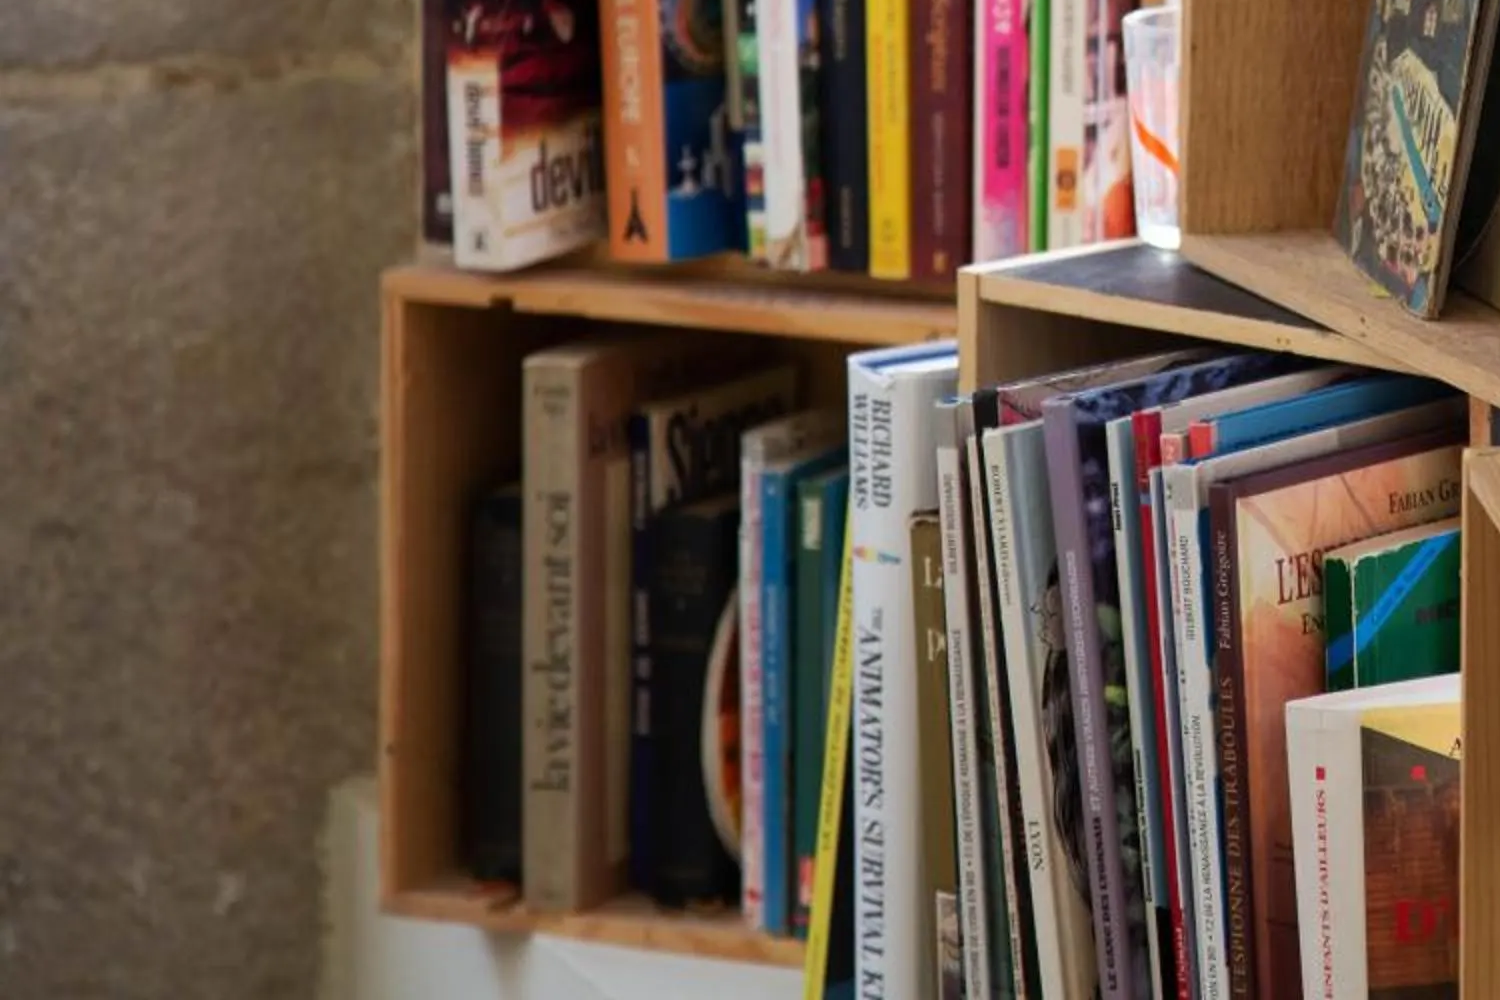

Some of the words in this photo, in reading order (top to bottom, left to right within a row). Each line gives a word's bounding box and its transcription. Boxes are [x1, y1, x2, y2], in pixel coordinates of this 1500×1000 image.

[852, 391, 869, 510] WILLIAMS
[871, 397, 892, 509] RICHARD
[534, 489, 571, 549] soi
[1388, 489, 1435, 515] FABIAN
[1276, 548, 1324, 606] L'ES
[530, 557, 571, 692] devant
[1218, 595, 1234, 651] Fabian
[857, 624, 885, 812] ANIMATOR'S
[1218, 674, 1240, 807] TRABOULES
[1027, 819, 1045, 872] LYON
[1224, 815, 1243, 858] DES
[1313, 789, 1331, 905] D'AILLEURS
[858, 818, 885, 962] SURVIVAL
[1098, 893, 1111, 923] DES
[1226, 866, 1253, 996] L'ESPIONNE
[860, 968, 885, 1000] KI
[1319, 910, 1335, 1000] ENFANTS
